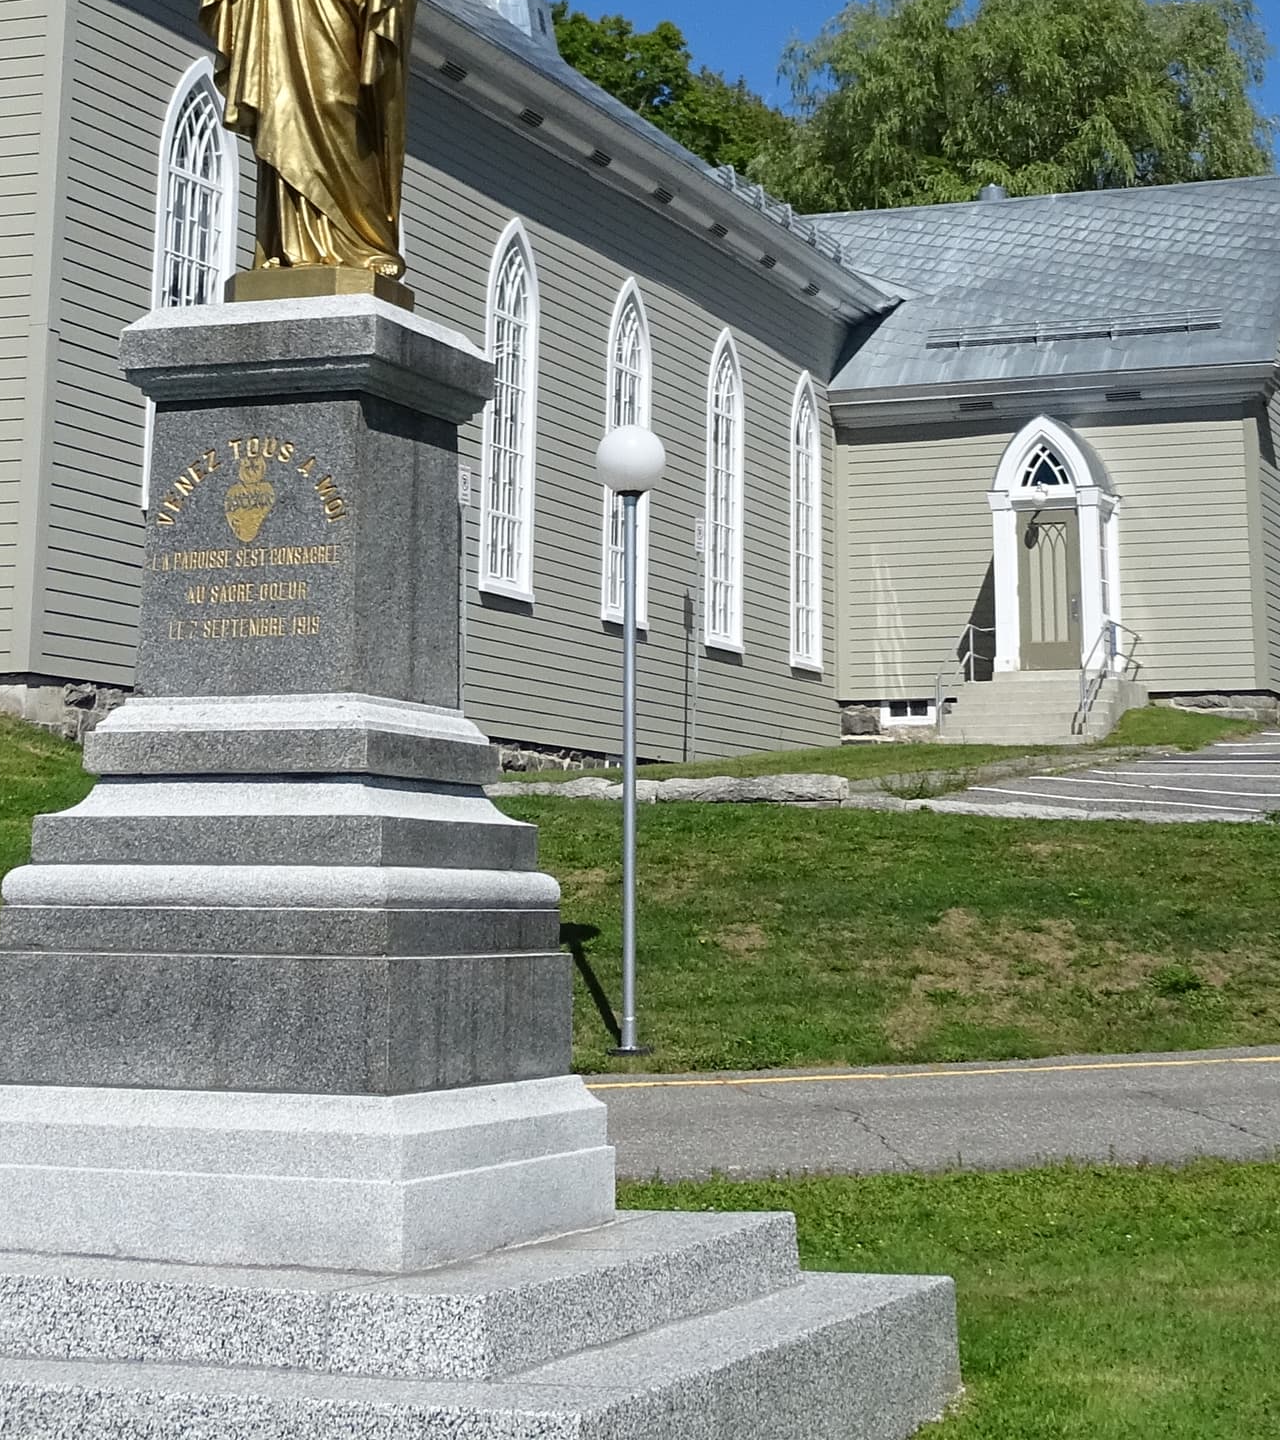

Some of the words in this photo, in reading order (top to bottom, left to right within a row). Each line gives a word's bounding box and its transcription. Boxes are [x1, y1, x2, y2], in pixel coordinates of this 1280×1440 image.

[157, 448, 221, 526] VENEZ
[228, 436, 295, 463] TOUS
[314, 474, 347, 523] MOI
[152, 553, 169, 571] LA
[173, 549, 232, 570] PAROISSE
[186, 585, 206, 604] AU
[202, 616, 287, 639] SEPTEMBRE
